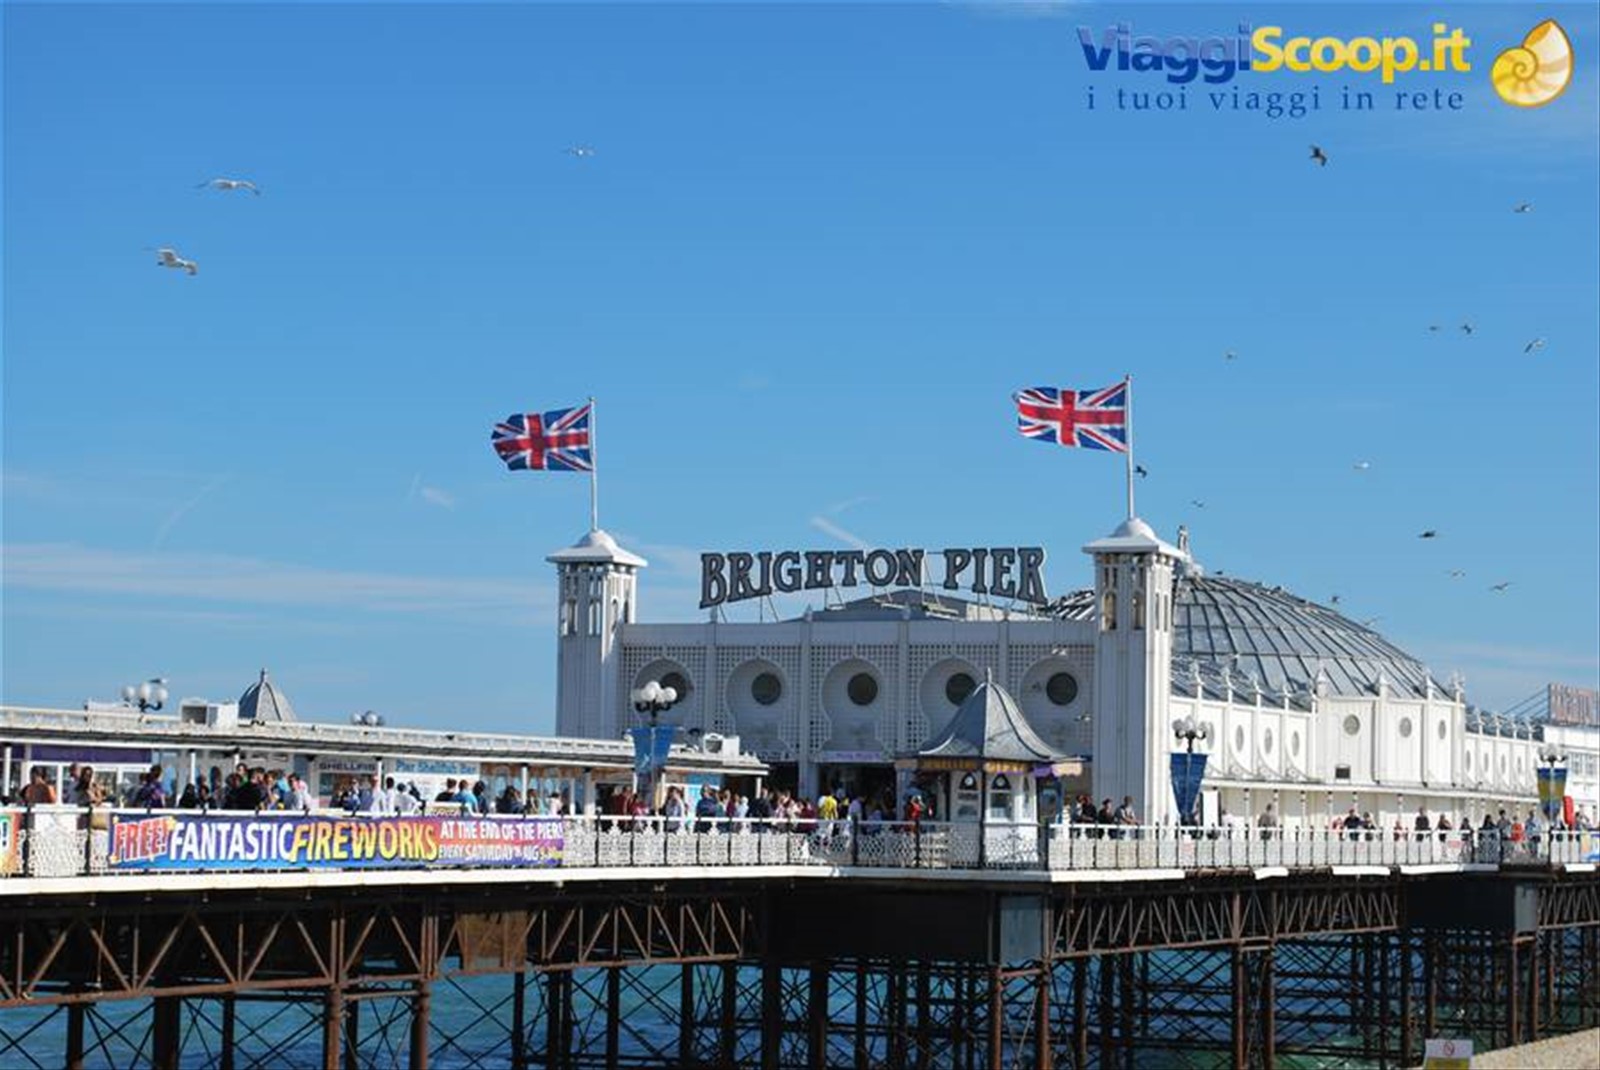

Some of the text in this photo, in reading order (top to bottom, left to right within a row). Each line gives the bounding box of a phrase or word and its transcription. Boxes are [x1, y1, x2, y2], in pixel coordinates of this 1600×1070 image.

[700, 547, 1047, 608] BRIGHTON PIER
[113, 818, 438, 862] FREE! FANTASTIC FIREWORKS
[441, 821, 454, 839] AT
[457, 821, 478, 839] THE
[480, 821, 500, 839] END
[502, 823, 516, 840] OF
[517, 823, 536, 840] THE
[465, 844, 513, 861] SATURDAY
